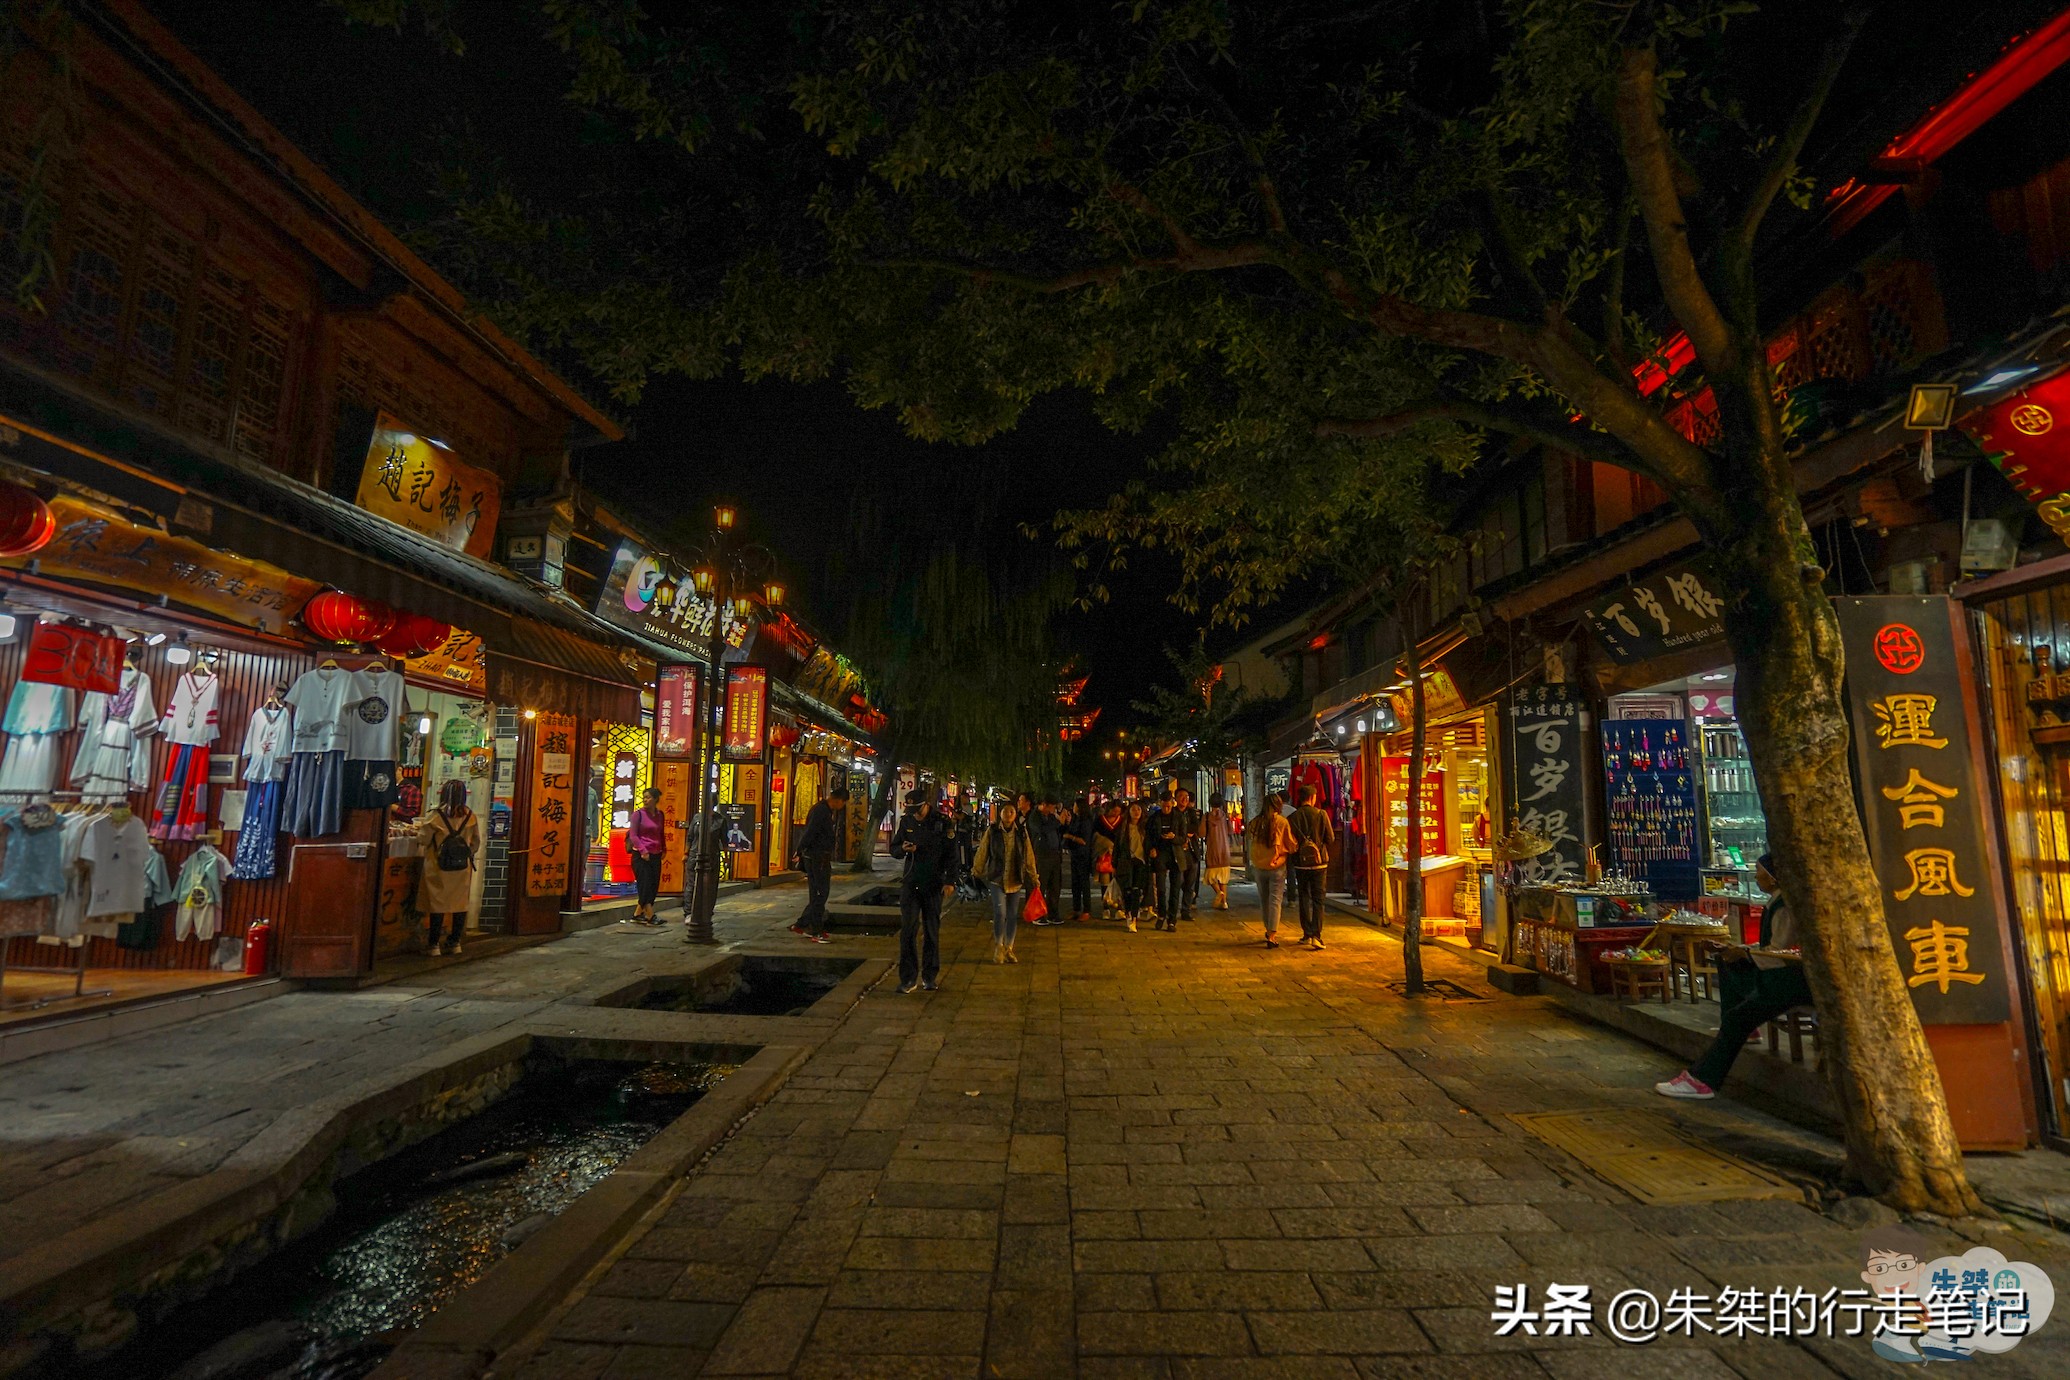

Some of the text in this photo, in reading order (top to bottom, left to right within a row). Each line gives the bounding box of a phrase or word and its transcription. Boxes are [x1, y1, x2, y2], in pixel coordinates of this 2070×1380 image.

[644, 622, 712, 658] JIAHUA FLOWERS PAS
[1662, 632, 1693, 648] Hundred
[1694, 629, 1709, 642] year
[682, 681, 692, 716] 保护洱海
[1516, 686, 1567, 701] 老字号
[661, 700, 672, 735] 爱我家园
[745, 769, 756, 801] 全国
[900, 780, 914, 790] 29
[1874, 694, 1985, 994] 運合風車
[532, 862, 566, 876] 梅子酒
[531, 878, 565, 891] 木瓜酒
